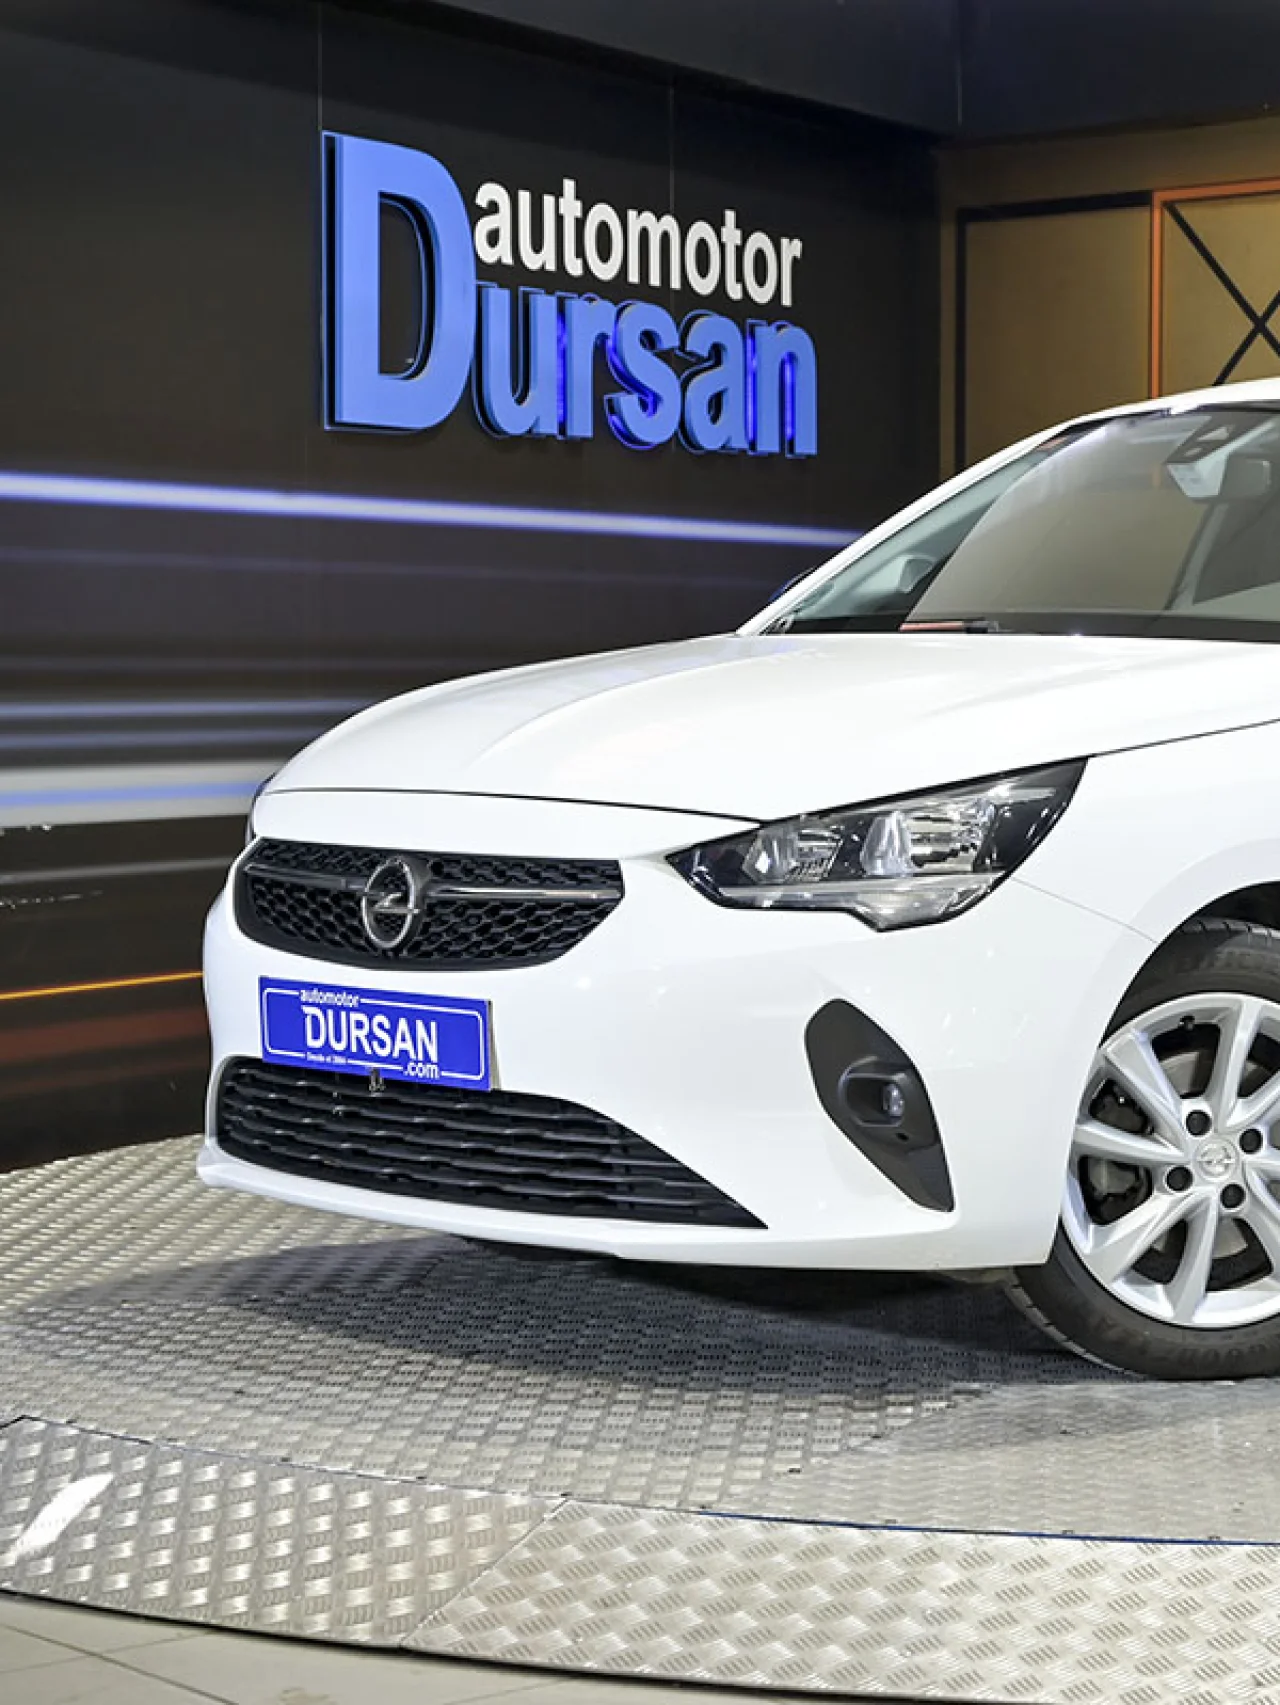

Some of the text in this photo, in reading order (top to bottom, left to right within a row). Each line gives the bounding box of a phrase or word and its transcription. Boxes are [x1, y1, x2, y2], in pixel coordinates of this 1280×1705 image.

[475, 179, 802, 307] automotor
[322, 130, 818, 458] Dursan
[300, 988, 361, 1008] automotor
[302, 1005, 438, 1064] DURSAN
[404, 1062, 440, 1080] .com
